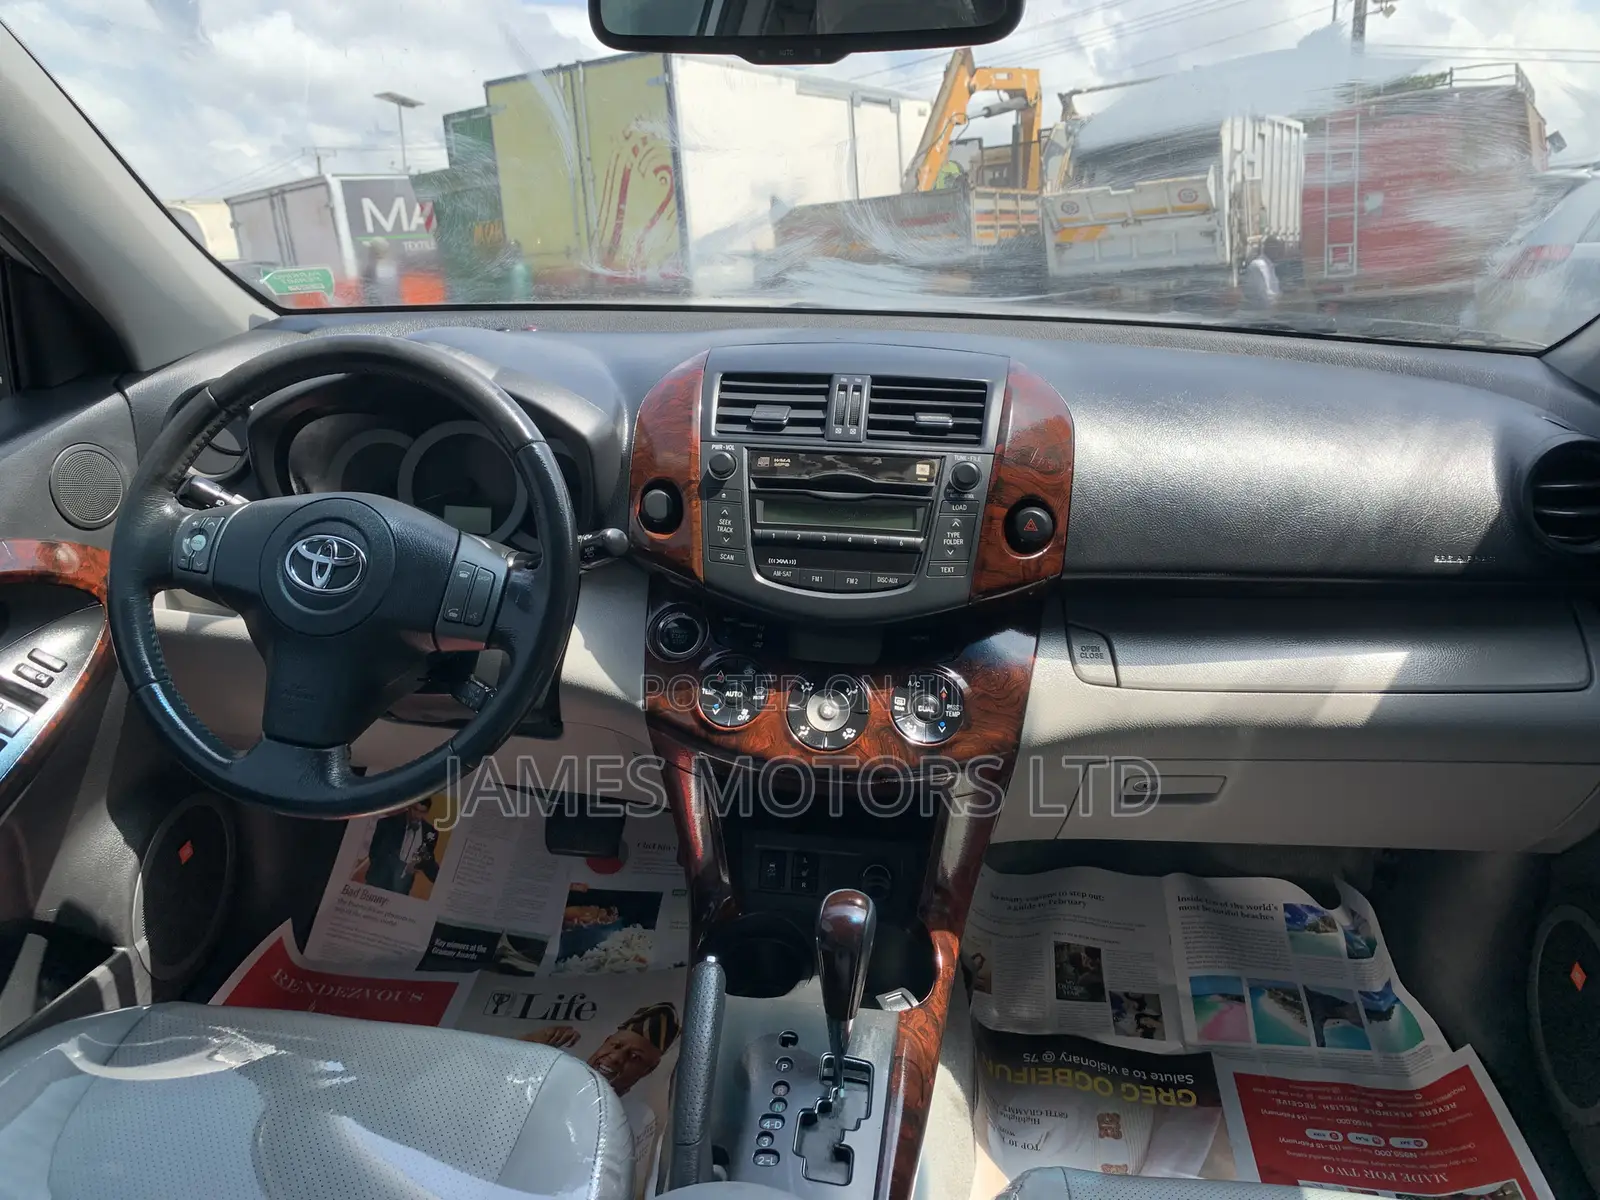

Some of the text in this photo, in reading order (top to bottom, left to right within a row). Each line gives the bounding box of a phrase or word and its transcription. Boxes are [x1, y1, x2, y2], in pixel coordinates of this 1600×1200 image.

[718, 518, 732, 526] SEEK
[717, 525, 734, 533] TRACK
[719, 553, 735, 561] SCAN
[907, 680, 921, 688] A/C
[917, 705, 935, 713] DUAL
[945, 710, 961, 718] TEMP
[341, 884, 361, 897] Bad
[1069, 890, 1087, 899] step
[1048, 898, 1087, 909] February
[1230, 902, 1243, 910] the
[1246, 903, 1279, 911] world's
[1202, 904, 1239, 917] beautiful
[1240, 911, 1275, 921] beaches
[270, 968, 425, 1003] RENDEZVOUS
[512, 992, 598, 1021] Life
[781, 1063, 788, 1072] P
[1022, 1050, 1194, 1085] Salute to a visionary @ 75
[1121, 1083, 1198, 1107] GREG
[763, 1120, 782, 1129] 4-D
[1021, 1141, 1040, 1151] TOP
[1324, 1164, 1449, 1184] MADE FOR TWO
